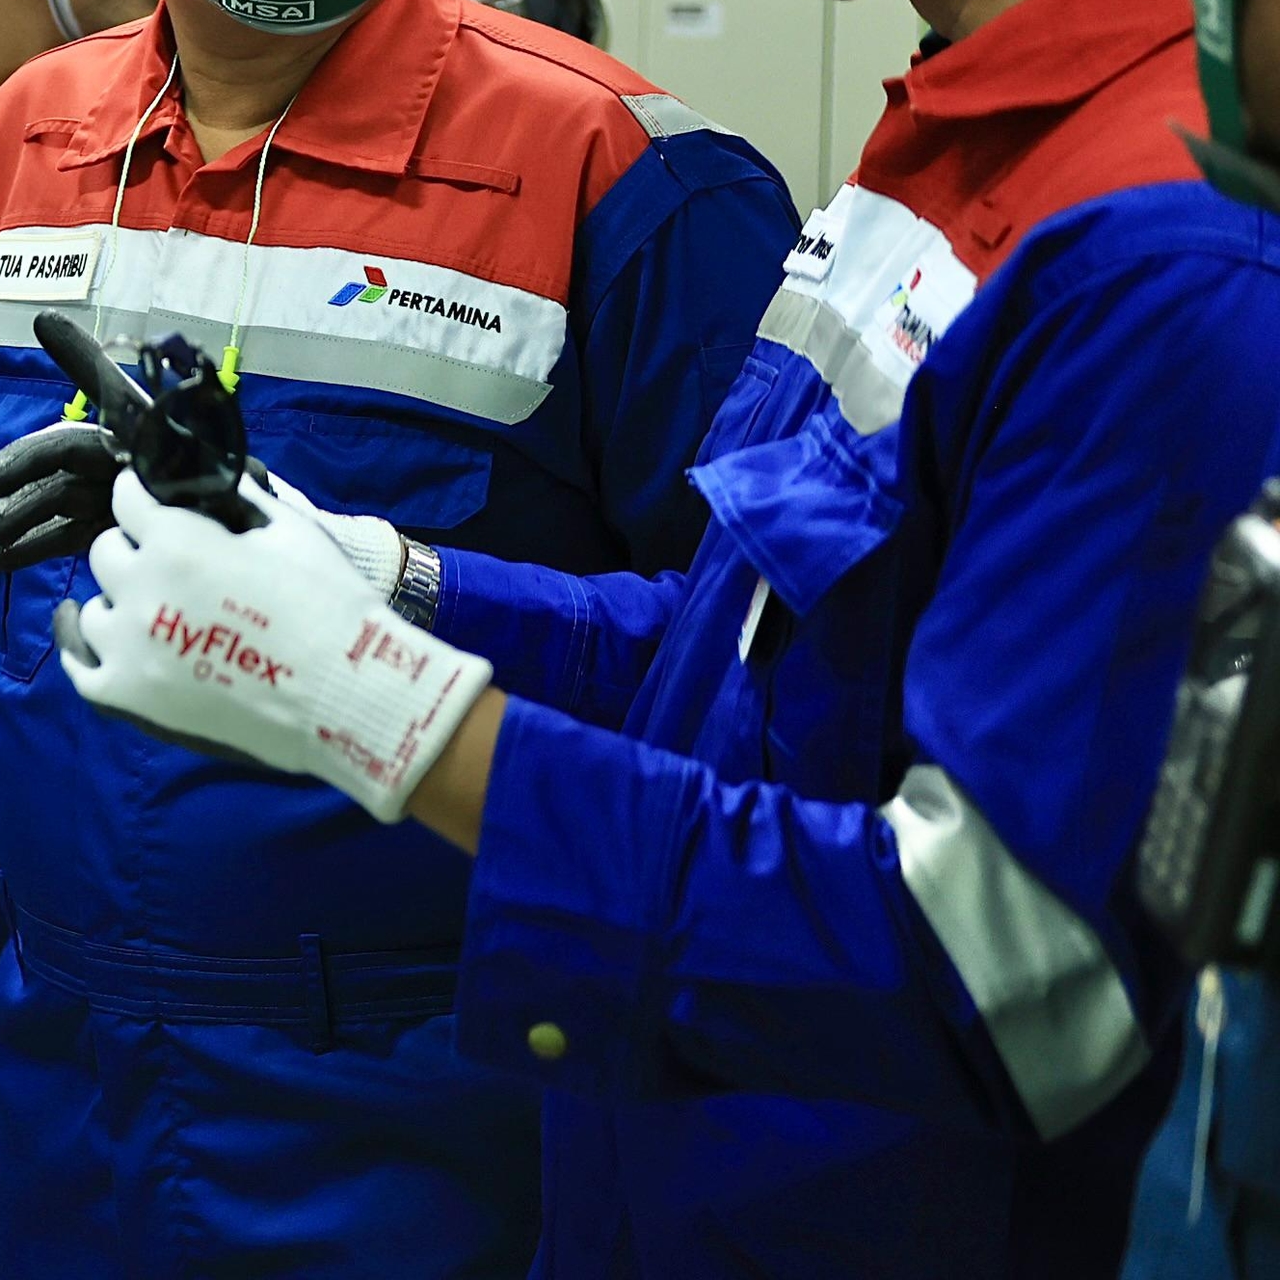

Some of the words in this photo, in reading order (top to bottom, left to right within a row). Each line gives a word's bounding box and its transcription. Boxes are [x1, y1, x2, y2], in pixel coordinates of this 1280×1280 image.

[26, 253, 89, 280] PASARIBU
[388, 288, 501, 333] PERTAMINA
[149, 603, 284, 687] HyFlex
